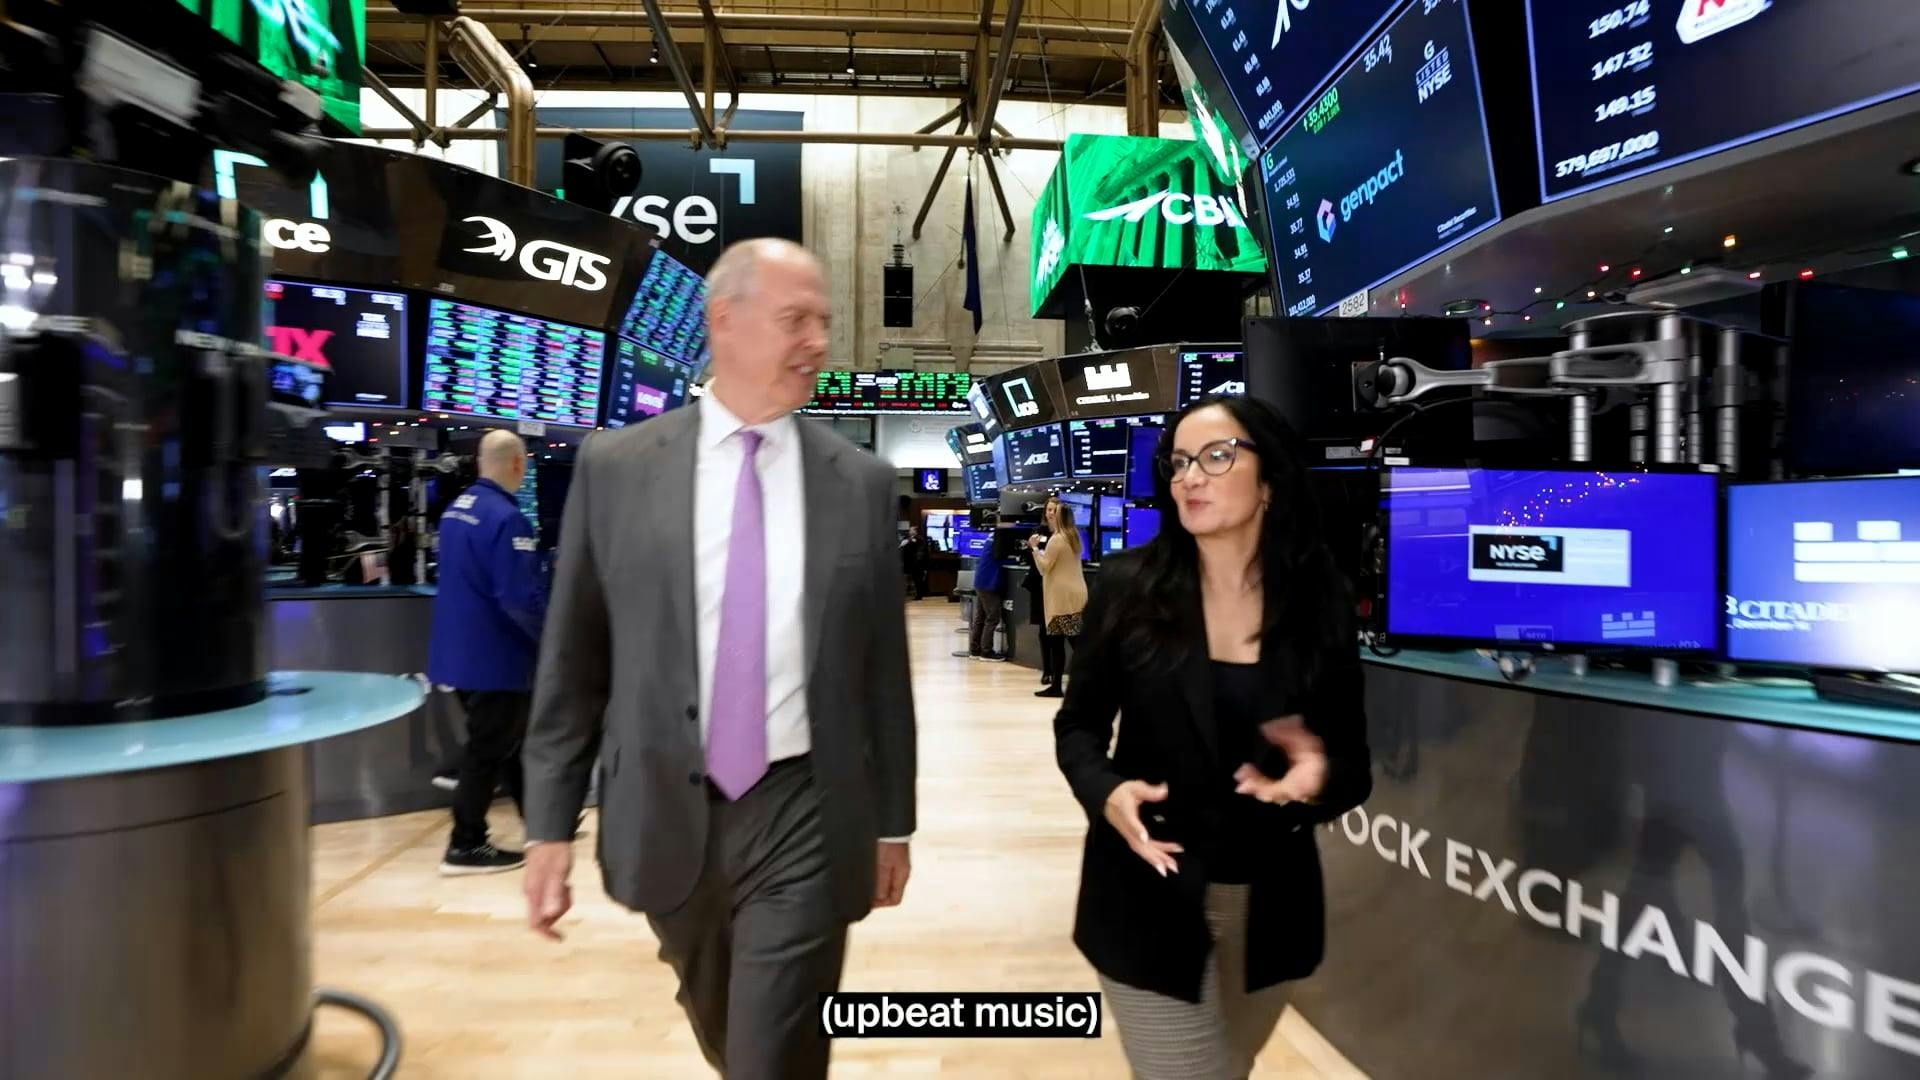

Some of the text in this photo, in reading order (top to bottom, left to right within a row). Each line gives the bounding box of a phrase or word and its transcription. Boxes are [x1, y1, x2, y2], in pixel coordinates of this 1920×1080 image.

[1416, 50, 1449, 84] LISTED
[1424, 40, 1435, 60] G
[1591, 41, 1654, 81] 147.32
[1417, 64, 1452, 104] NYSE
[1340, 148, 1404, 223] genpact
[610, 195, 718, 244] se
[519, 239, 612, 291] GTS
[1342, 293, 1365, 315] 2582
[1328, 805, 1920, 1056] OCK EXCHANGE
